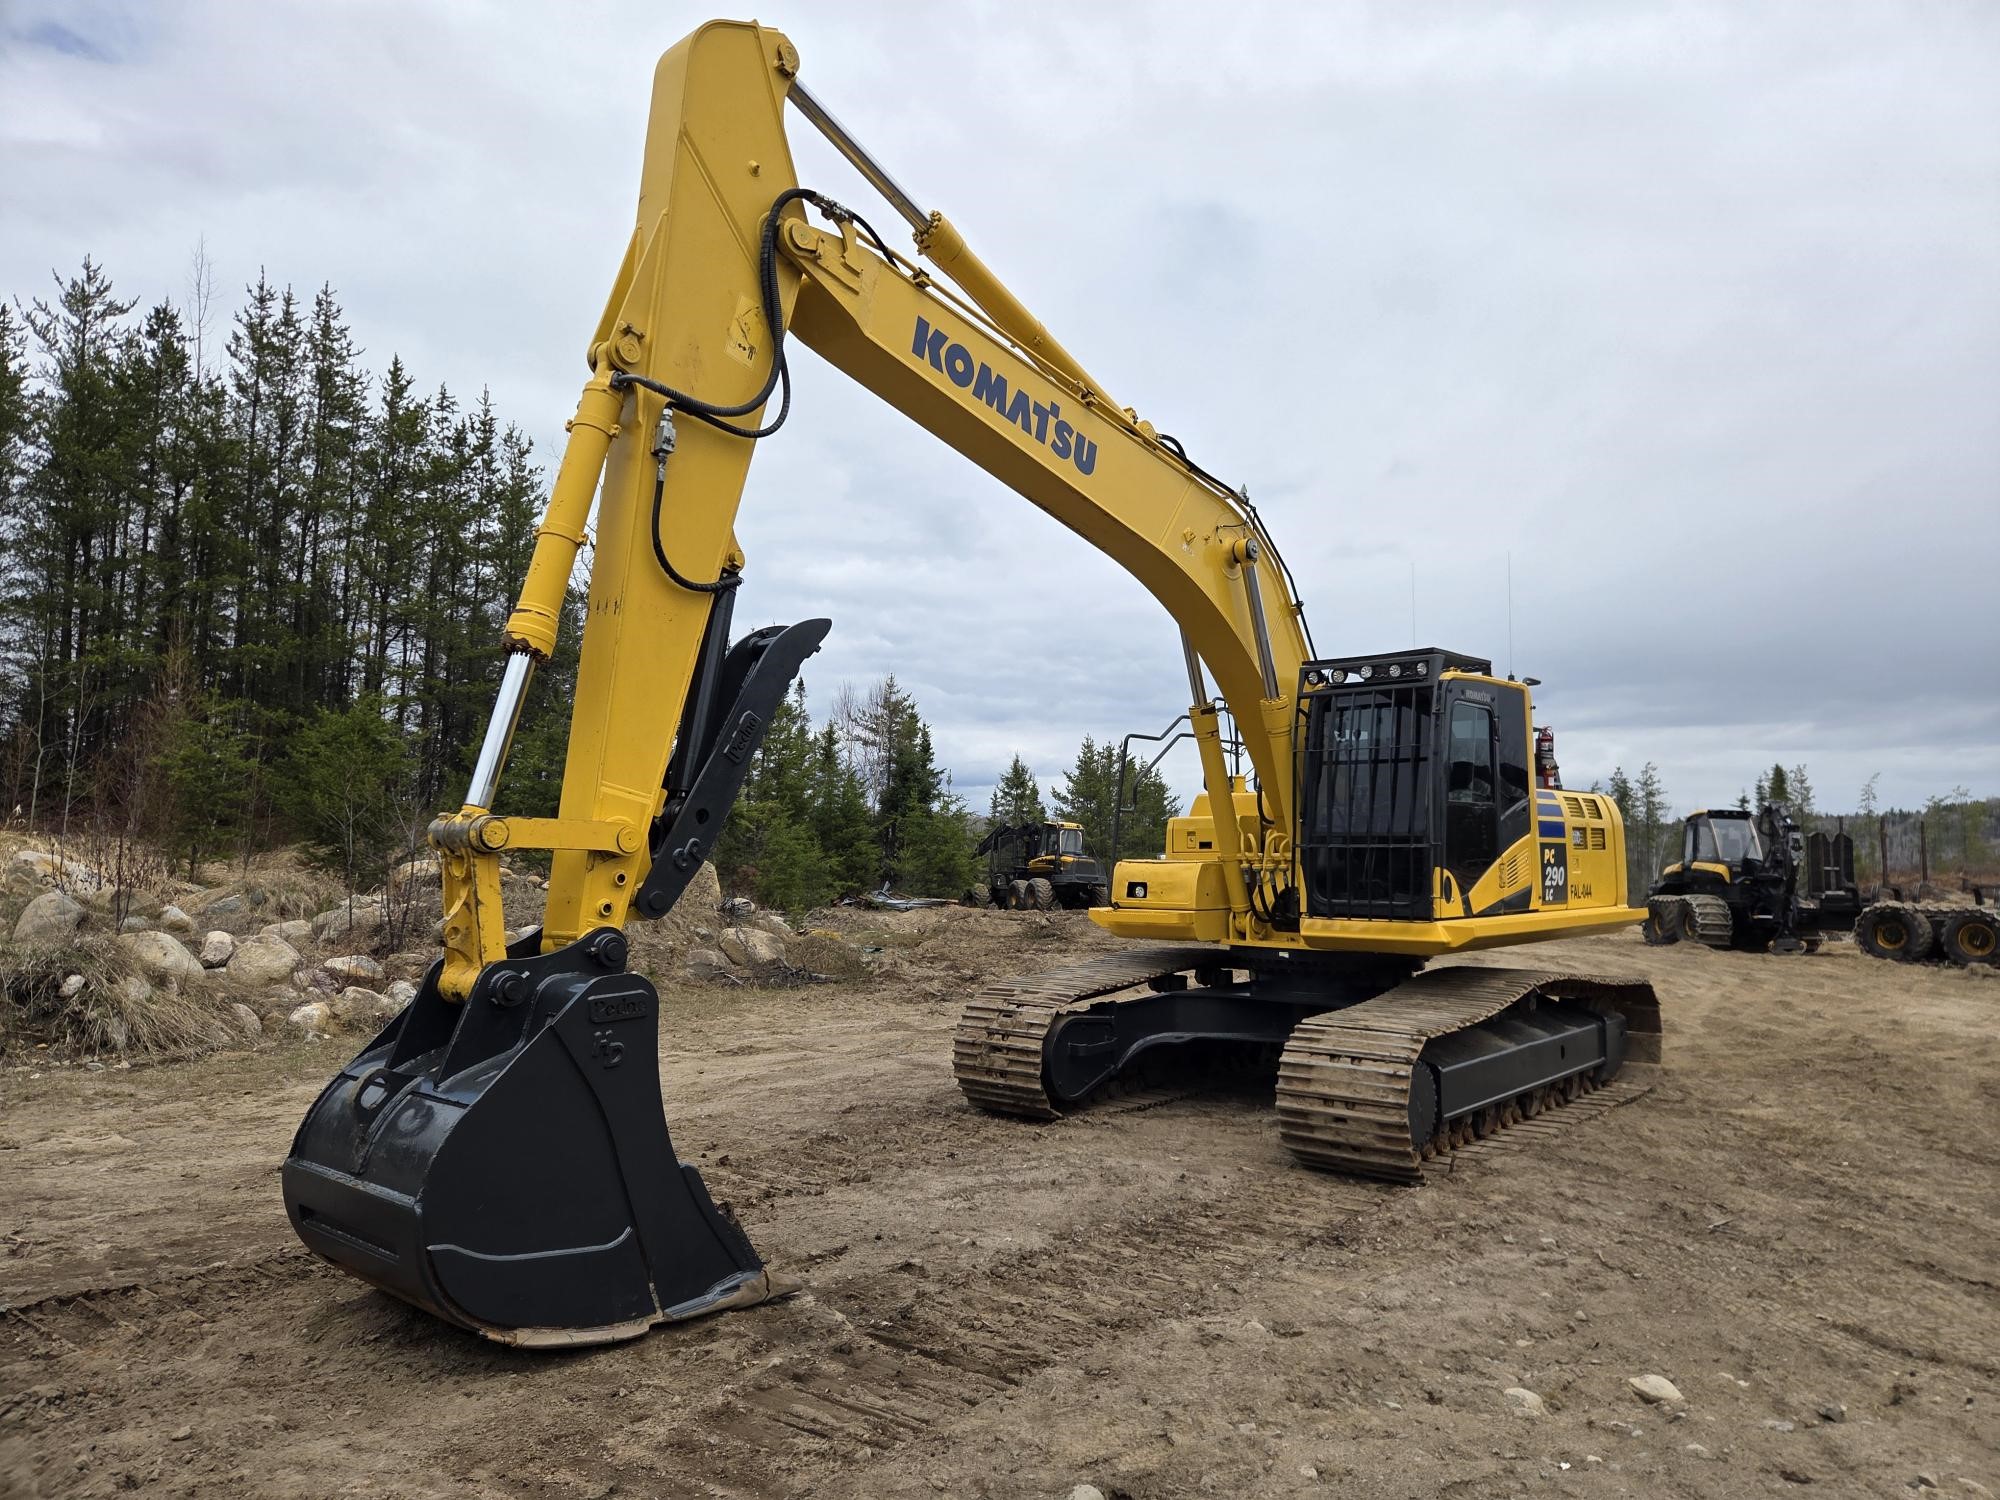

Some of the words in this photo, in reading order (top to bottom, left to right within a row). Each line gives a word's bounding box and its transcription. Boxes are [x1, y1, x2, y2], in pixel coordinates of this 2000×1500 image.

[911, 315, 1098, 476] KOMATSU
[1544, 848, 1555, 864] PC
[1545, 866, 1565, 886] 290
[1545, 888, 1554, 901] LC
